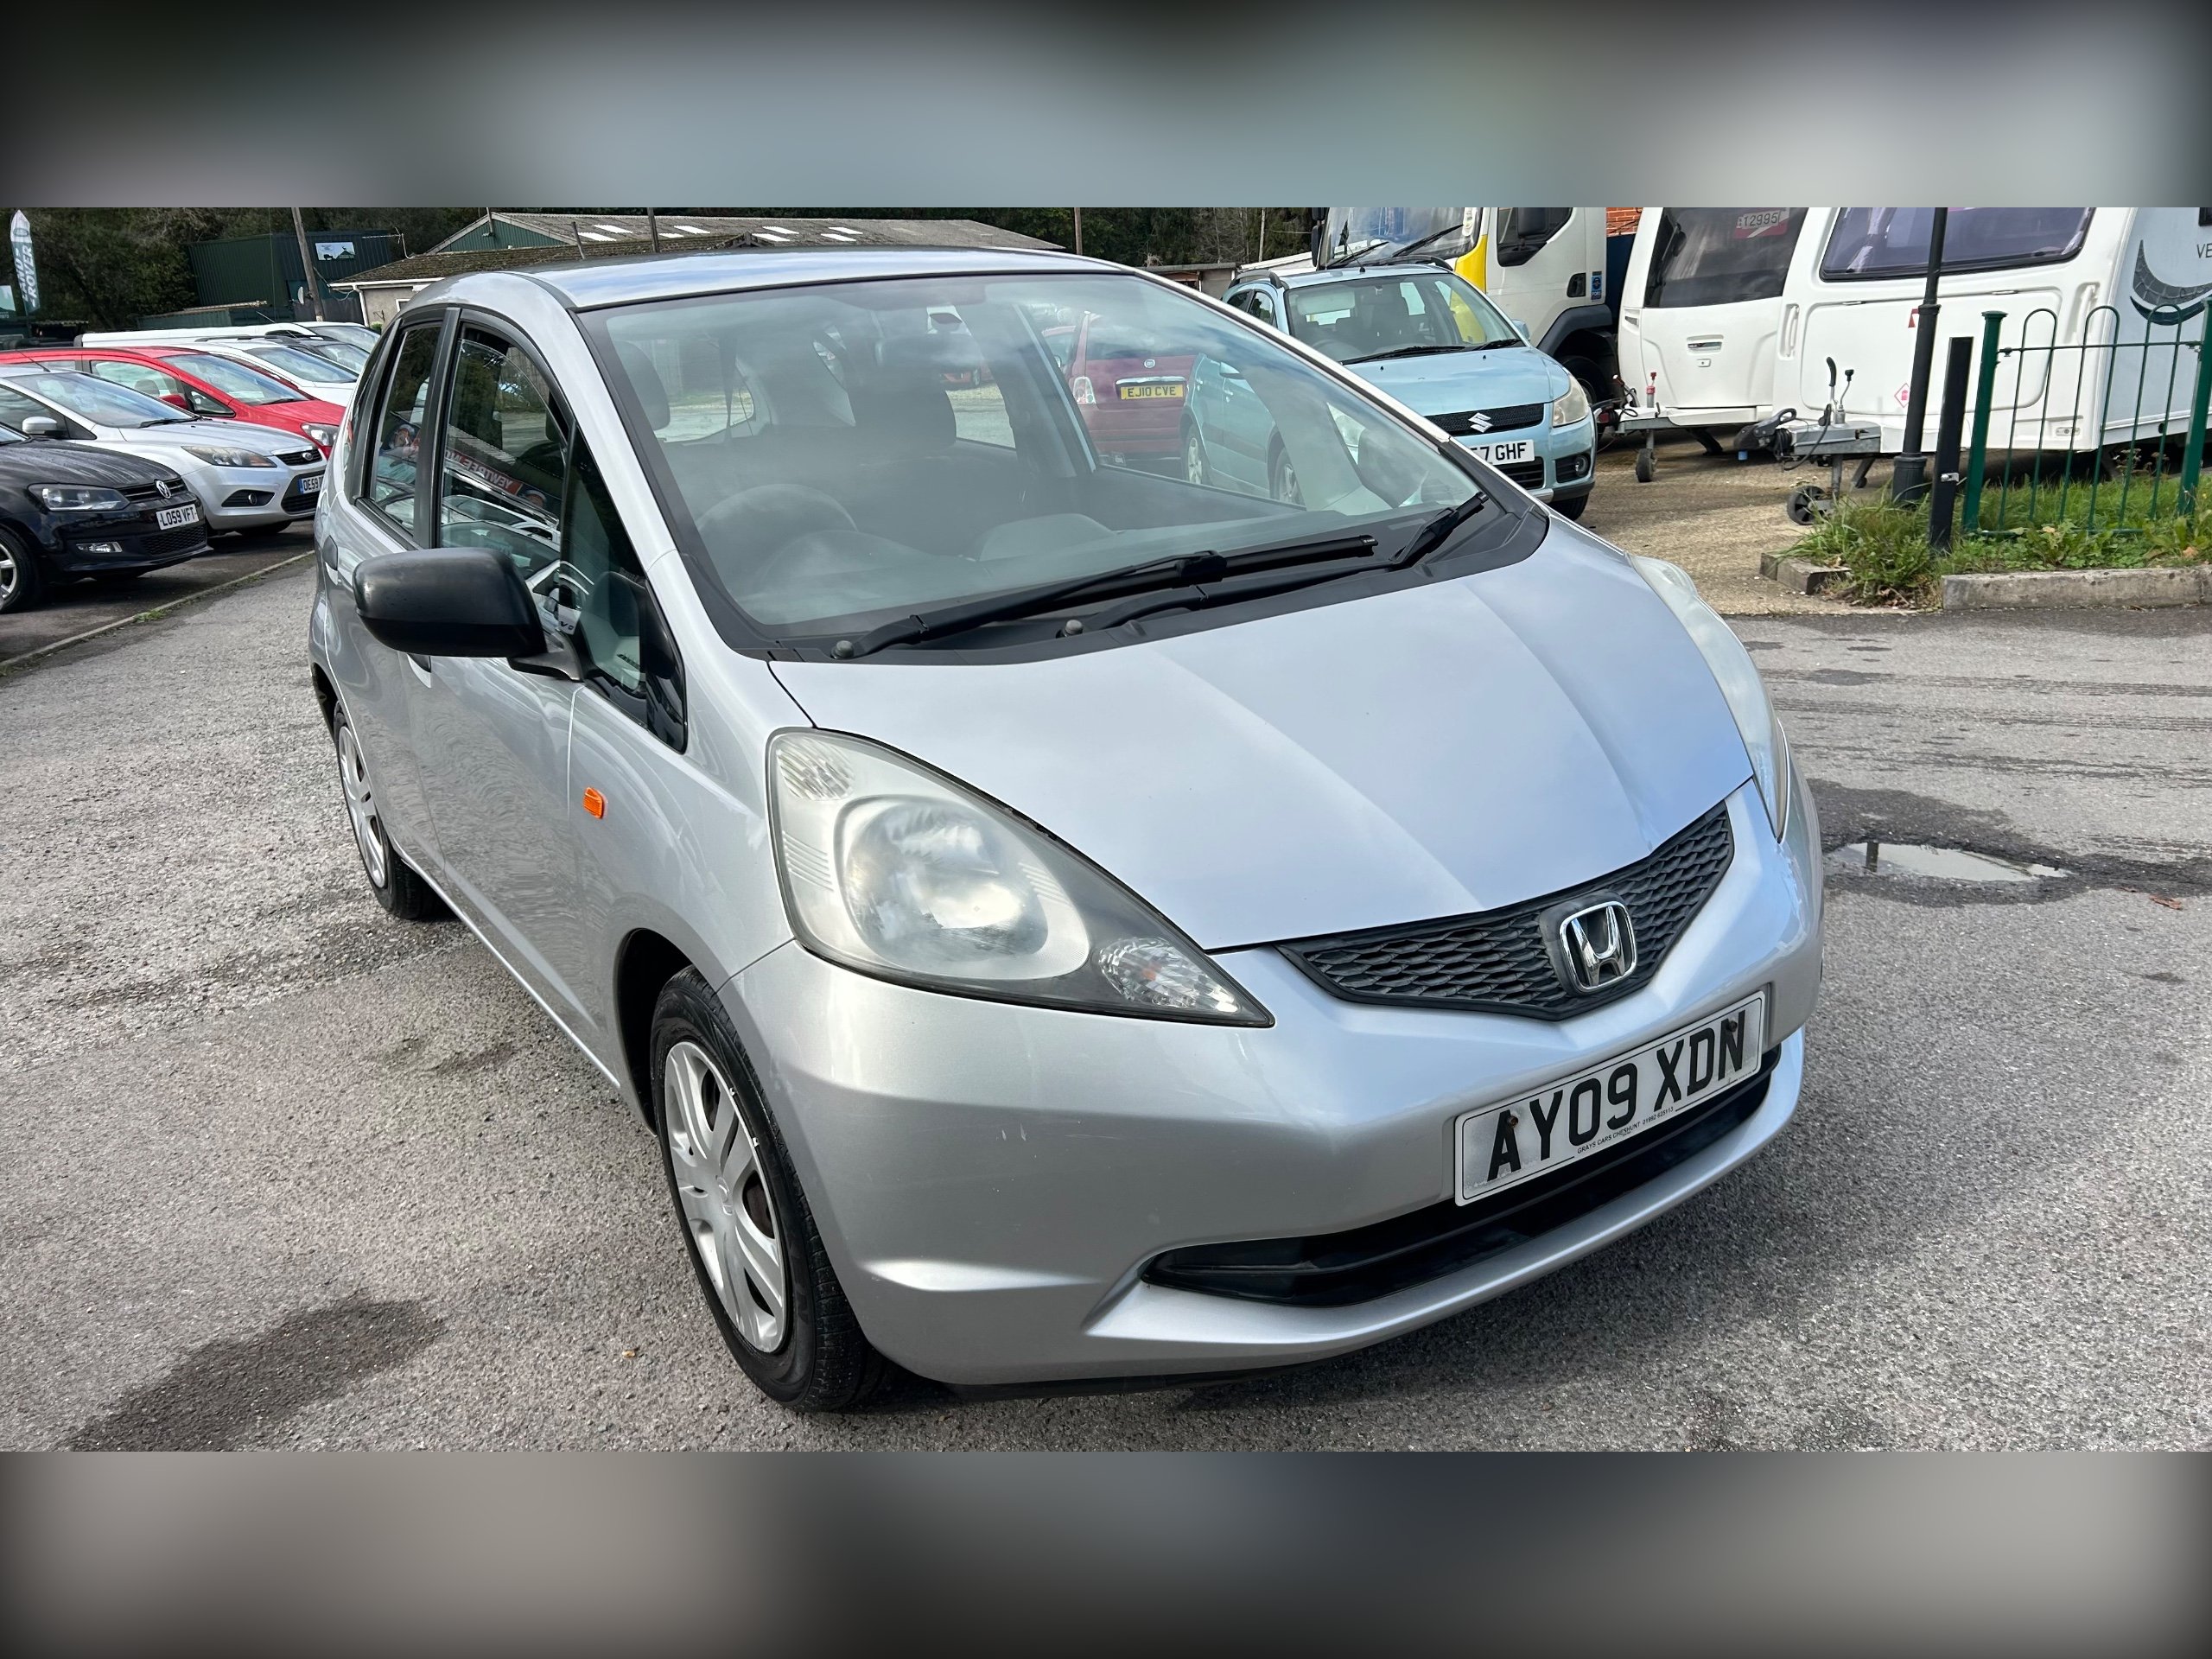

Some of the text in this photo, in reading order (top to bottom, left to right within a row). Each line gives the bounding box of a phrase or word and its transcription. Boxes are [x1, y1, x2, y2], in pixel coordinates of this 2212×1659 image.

[1128, 386, 1176, 397] EJ10 CVE
[1470, 442, 1527, 461] 7 GHF
[1487, 1009, 1745, 1182] AY09 XDN
[1577, 1141, 1596, 1154] GRAYS
[1597, 1135, 1612, 1146] CARS
[1612, 1121, 1641, 1138] CHESHUNT
